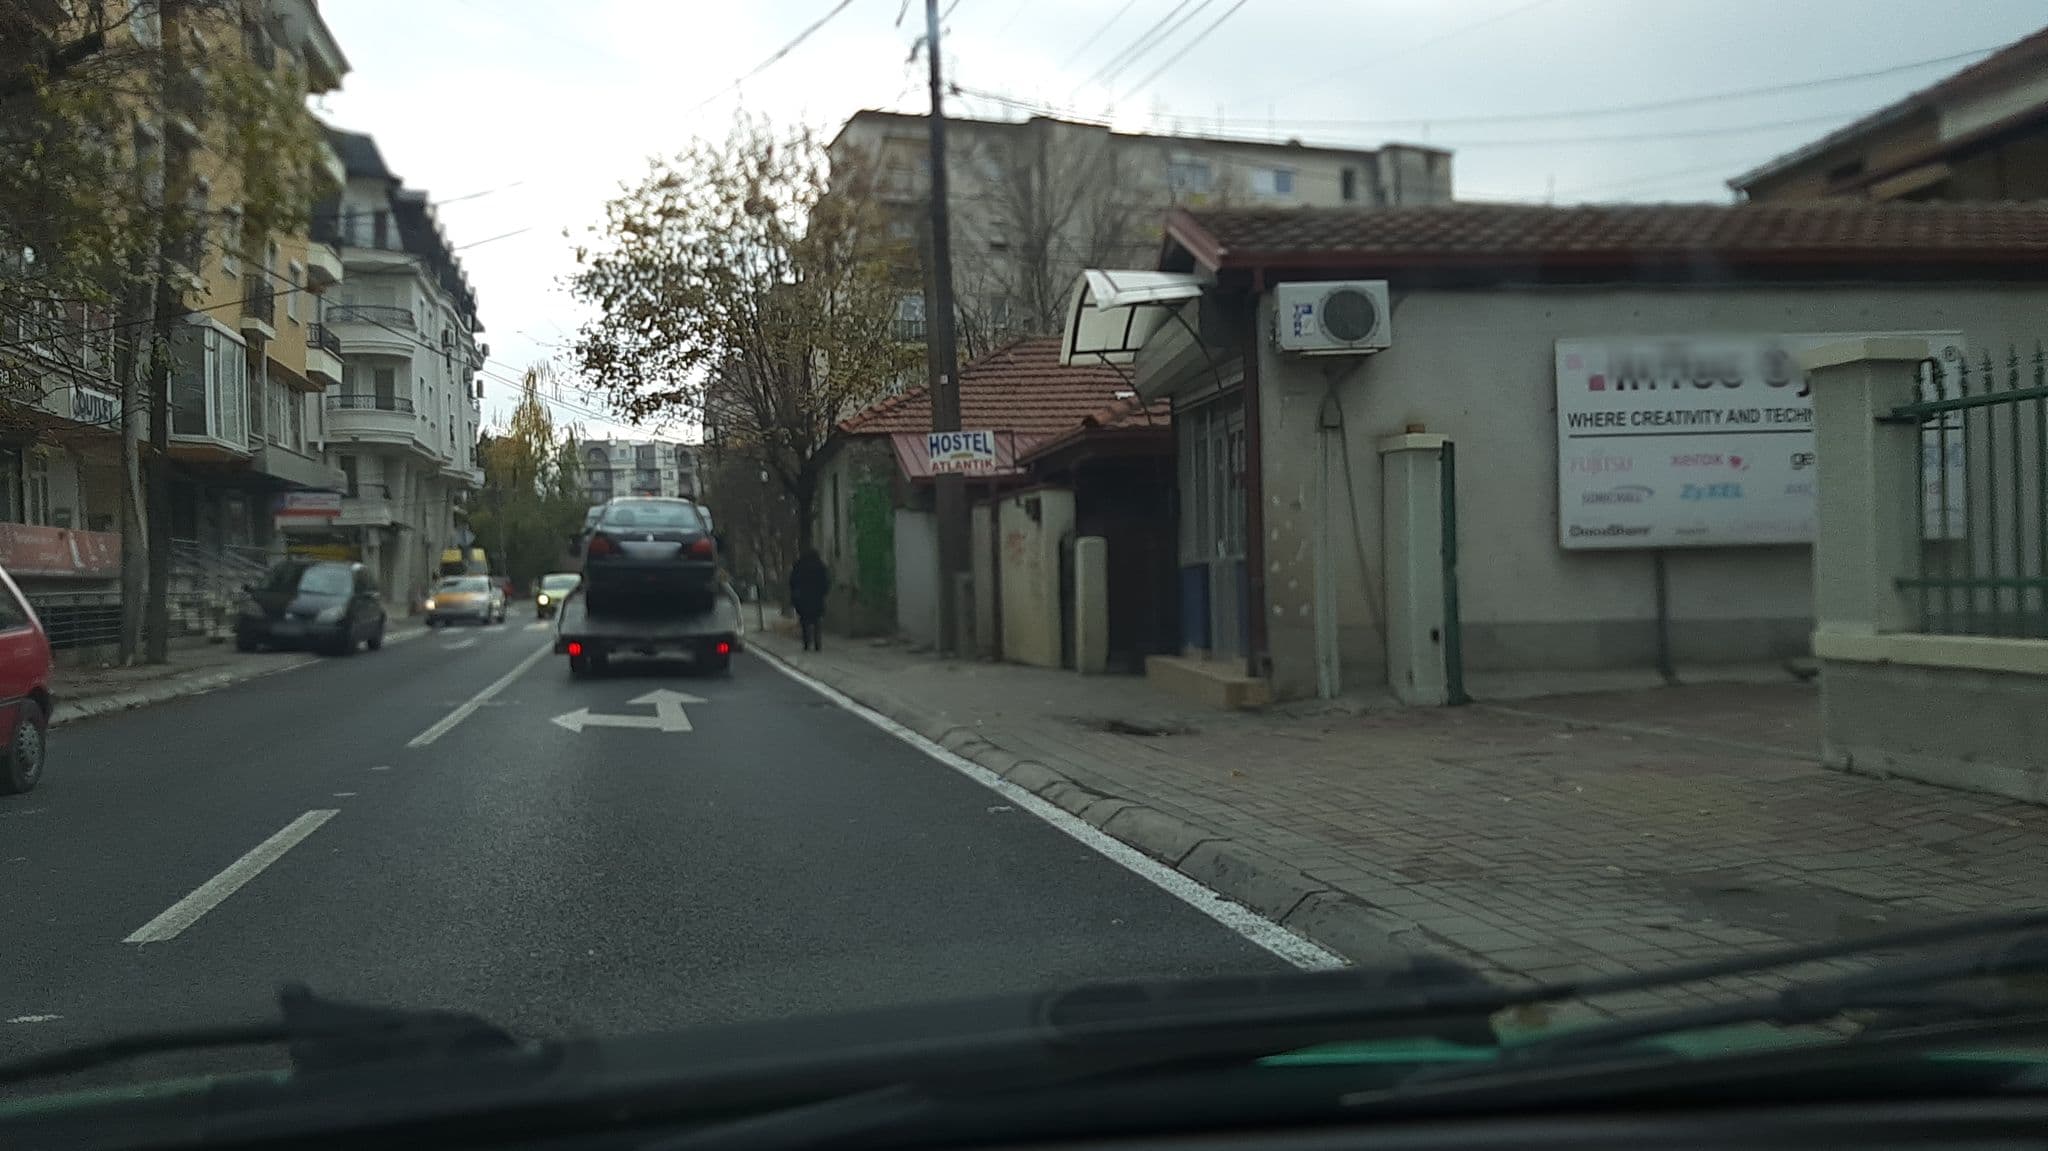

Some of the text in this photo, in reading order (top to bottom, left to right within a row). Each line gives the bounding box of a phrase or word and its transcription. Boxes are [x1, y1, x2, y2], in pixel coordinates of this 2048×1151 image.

[1567, 412, 1626, 427] WHERE
[1631, 410, 1722, 425] CREATIVITY
[1726, 409, 1760, 424] AND
[929, 432, 992, 458] HOSTEL
[932, 459, 992, 472] ATLANTIK
